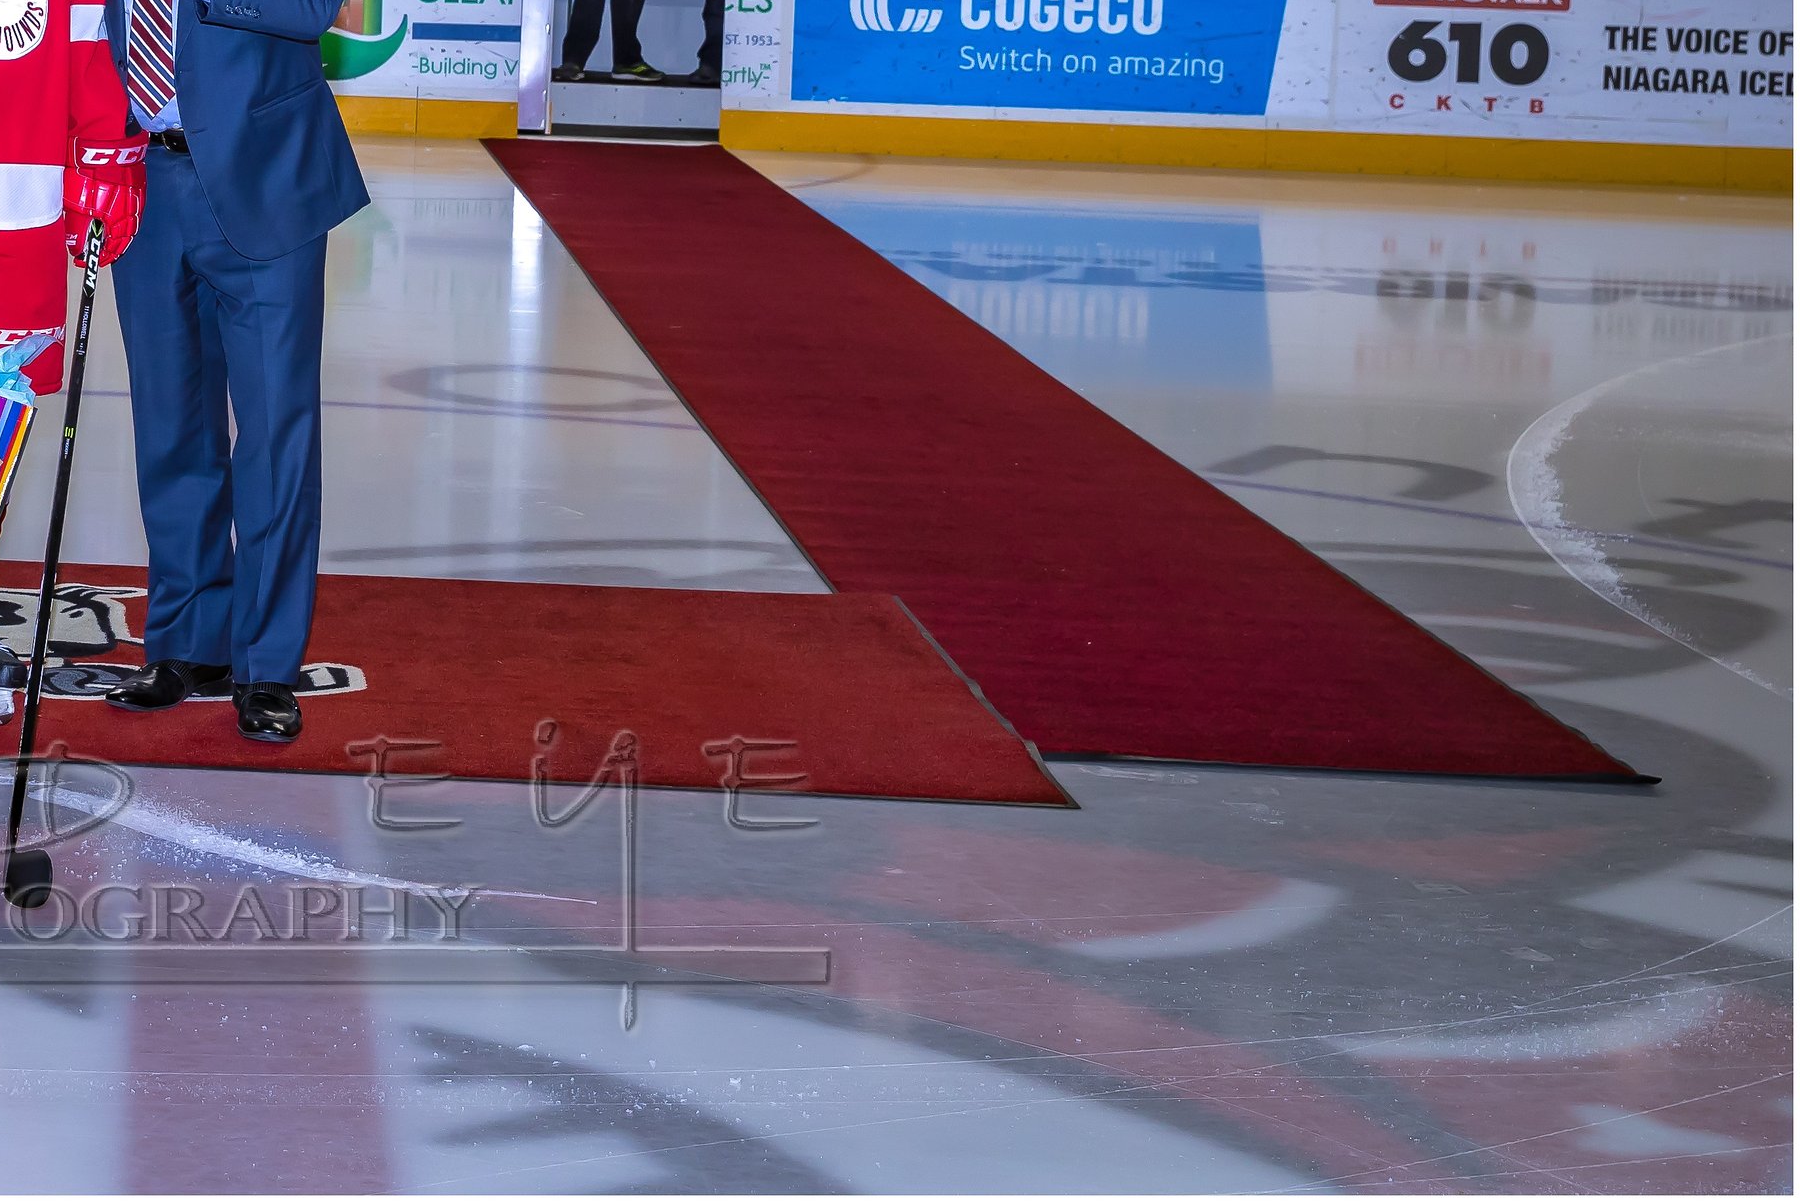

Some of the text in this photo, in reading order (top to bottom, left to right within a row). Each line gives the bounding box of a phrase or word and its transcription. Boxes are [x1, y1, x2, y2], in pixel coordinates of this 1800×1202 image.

[1387, 20, 1550, 86] 610
[1604, 25, 1657, 52] THE
[1666, 28, 1748, 56] VOICE
[958, 45, 1225, 84] Switch on amazing
[1603, 65, 1729, 96] NIAGARA
[85, 237, 101, 290] CCM
